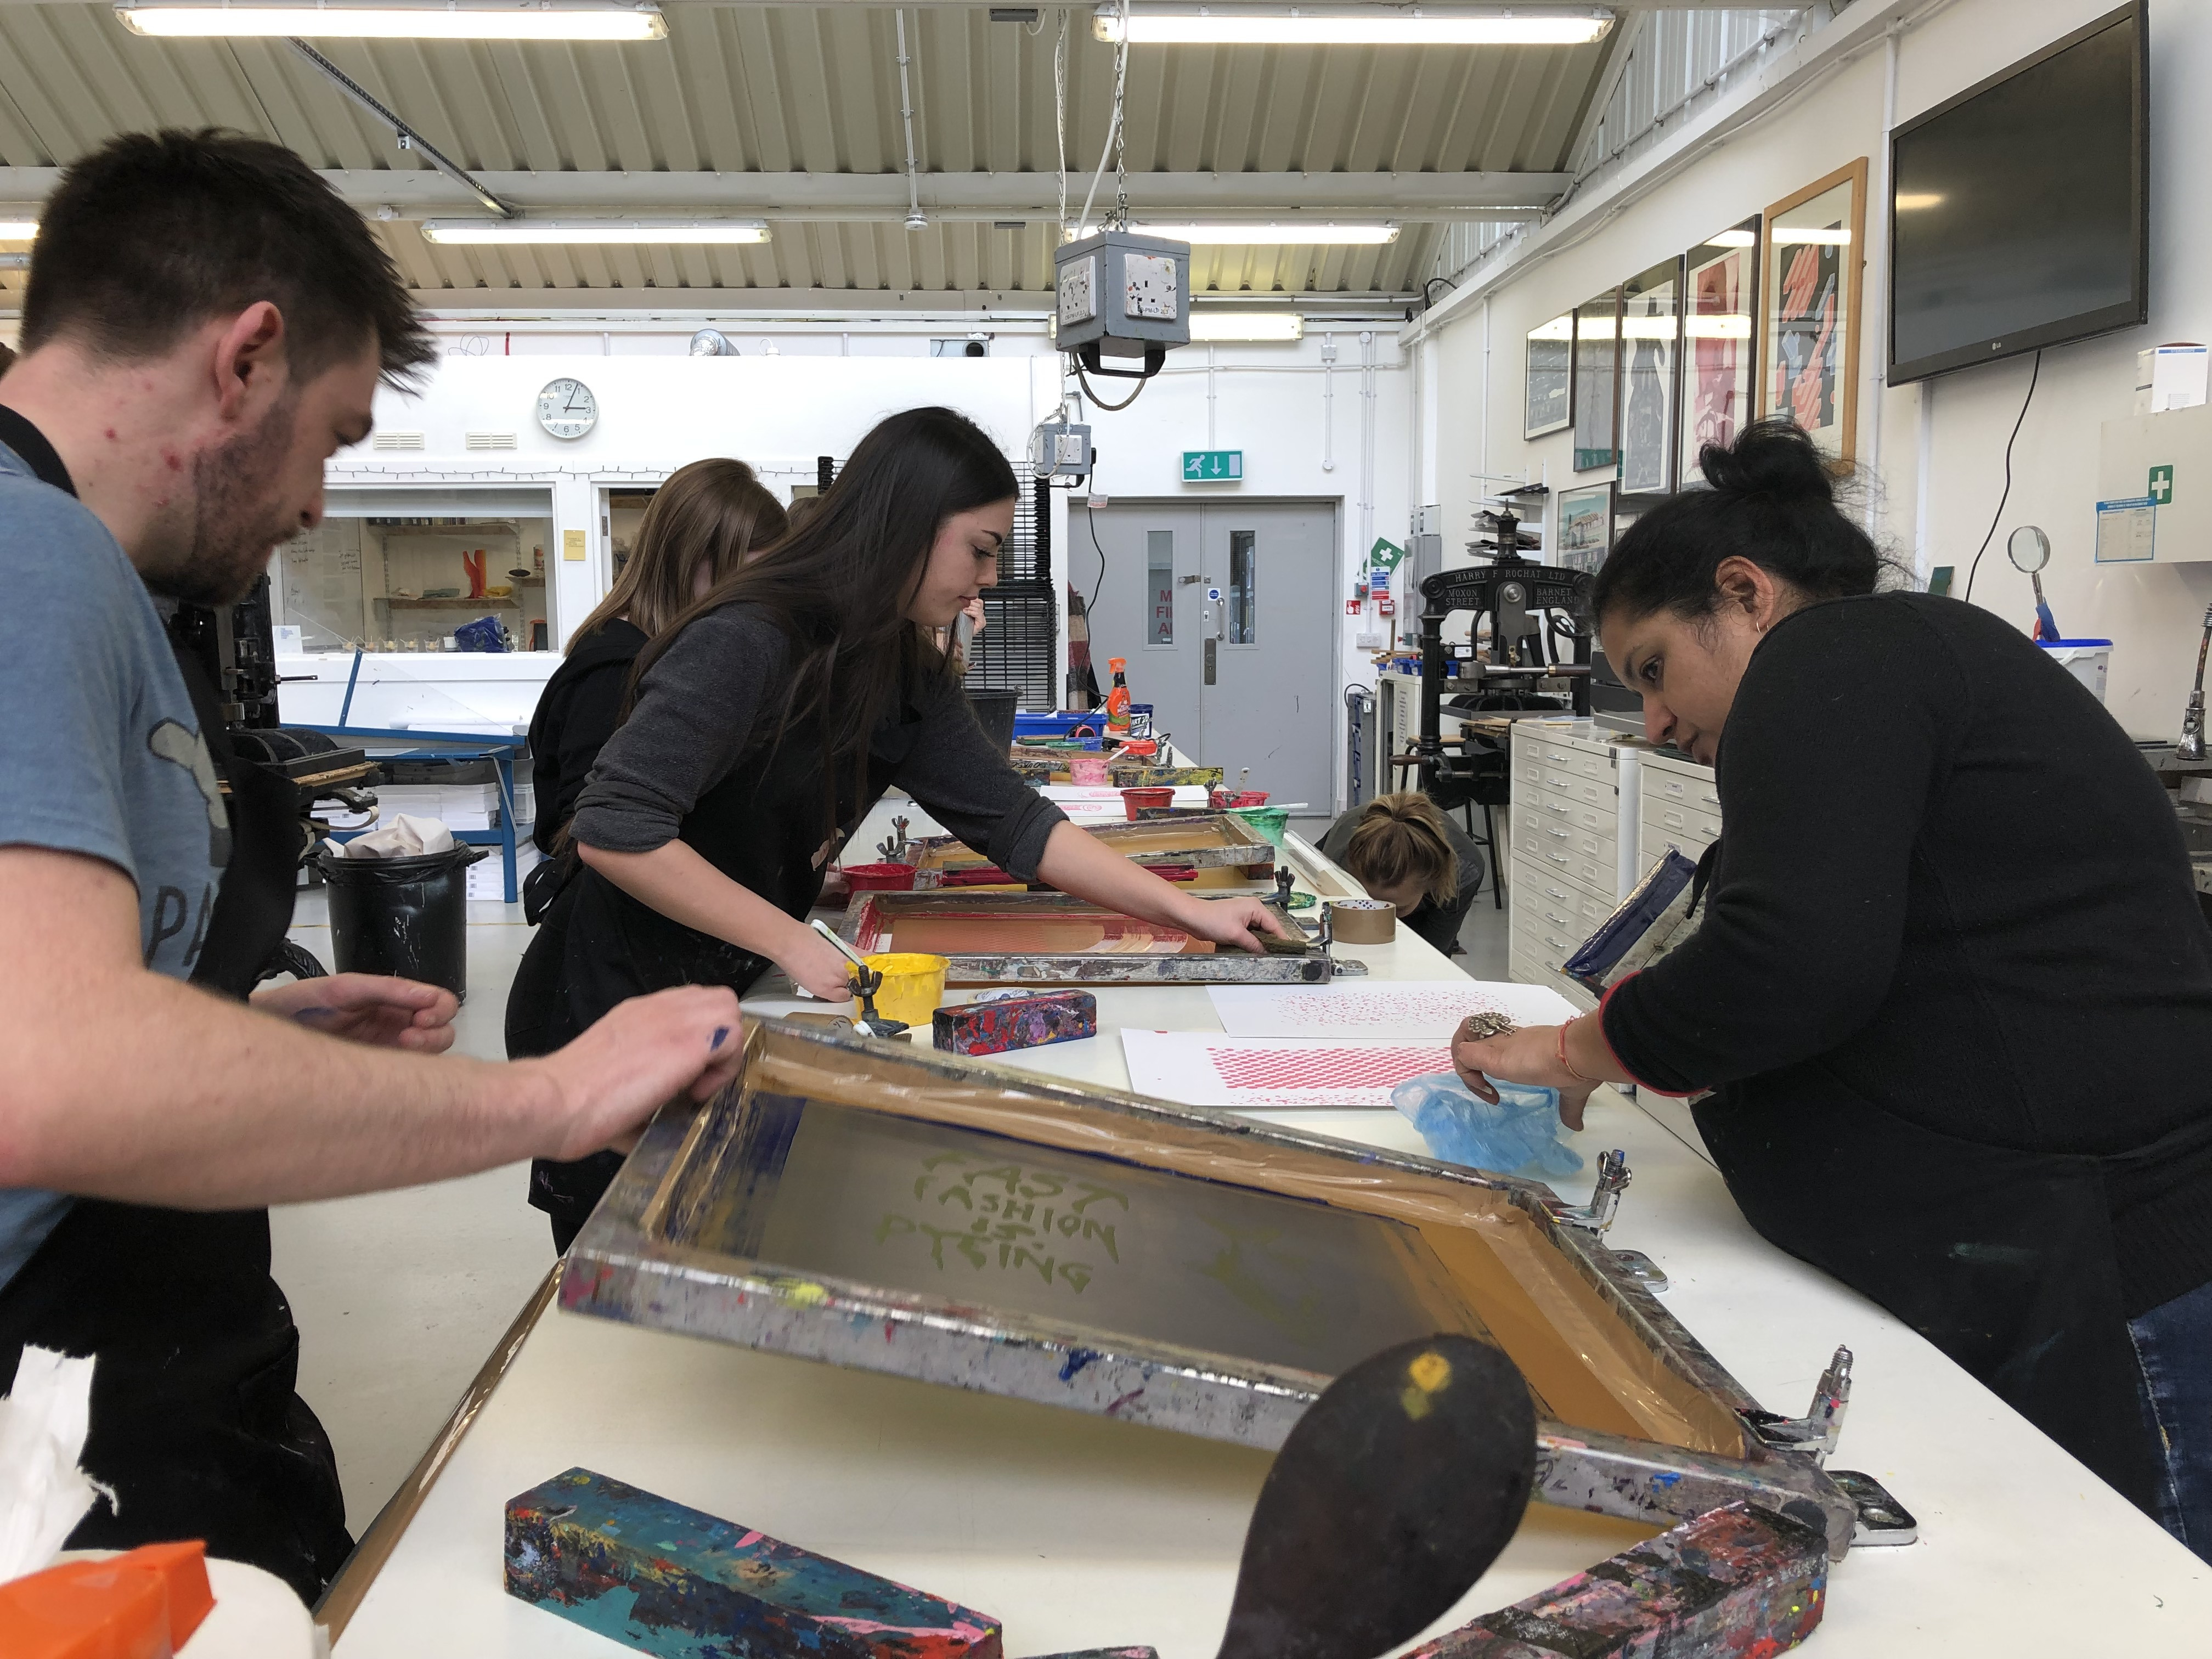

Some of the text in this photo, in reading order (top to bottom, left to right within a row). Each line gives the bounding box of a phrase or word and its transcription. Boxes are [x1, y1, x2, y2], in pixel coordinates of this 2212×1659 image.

[1455, 571, 1487, 583] HARRY
[1505, 570, 1541, 578] ROCHAT
[1549, 571, 1566, 581] LTD
[1448, 589, 1477, 597] MOXON
[1537, 588, 1571, 596] BARNET
[1445, 597, 1480, 606] STREET
[1537, 596, 1579, 604] ENGLAND
[913, 1175, 1120, 1264] FASHION
